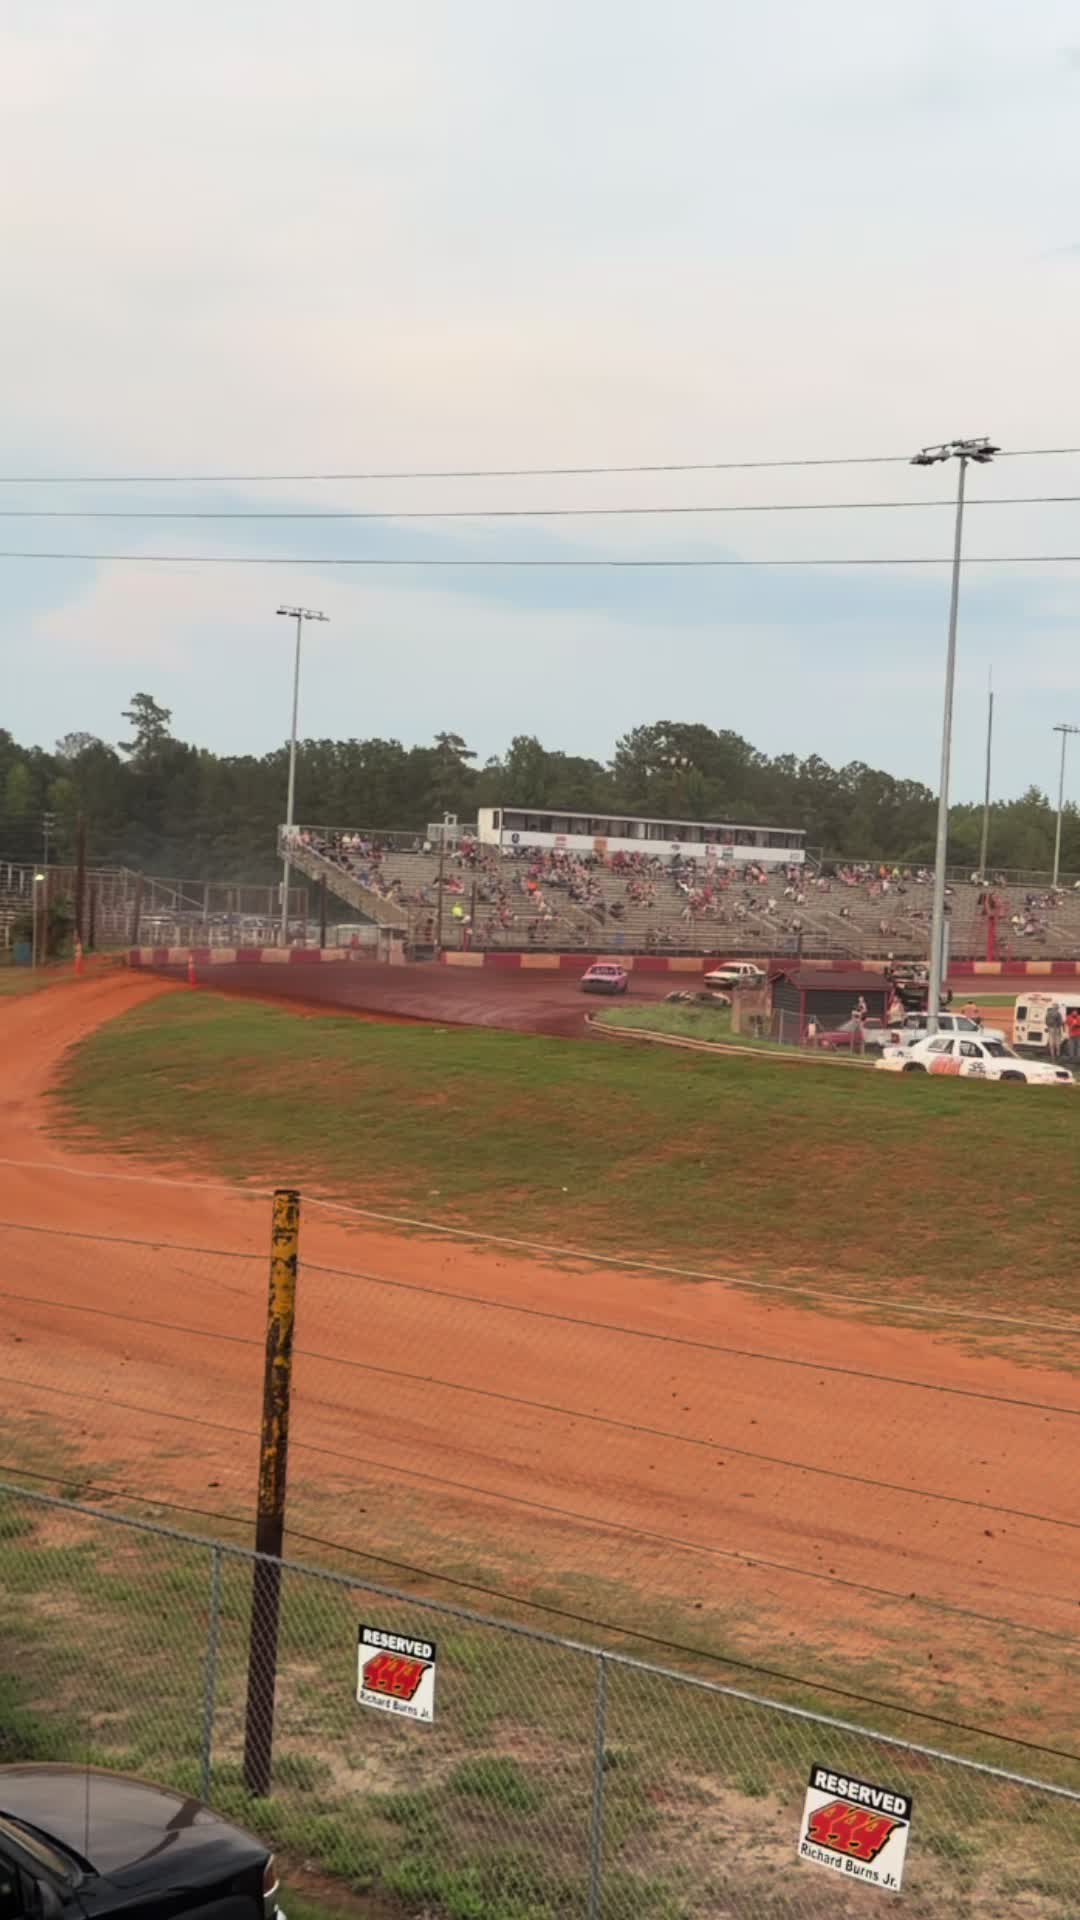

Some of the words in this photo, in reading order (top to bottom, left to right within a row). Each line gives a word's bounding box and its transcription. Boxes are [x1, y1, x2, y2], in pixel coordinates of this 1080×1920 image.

[363, 1629, 432, 1658] RESERVED
[360, 1690, 390, 1708] Richard
[392, 1700, 417, 1717] Burns
[814, 1770, 907, 1815] RESERVED
[800, 1843, 842, 1868] Richard
[845, 1859, 879, 1882] Burns
[882, 1872, 897, 1888] Jr.
